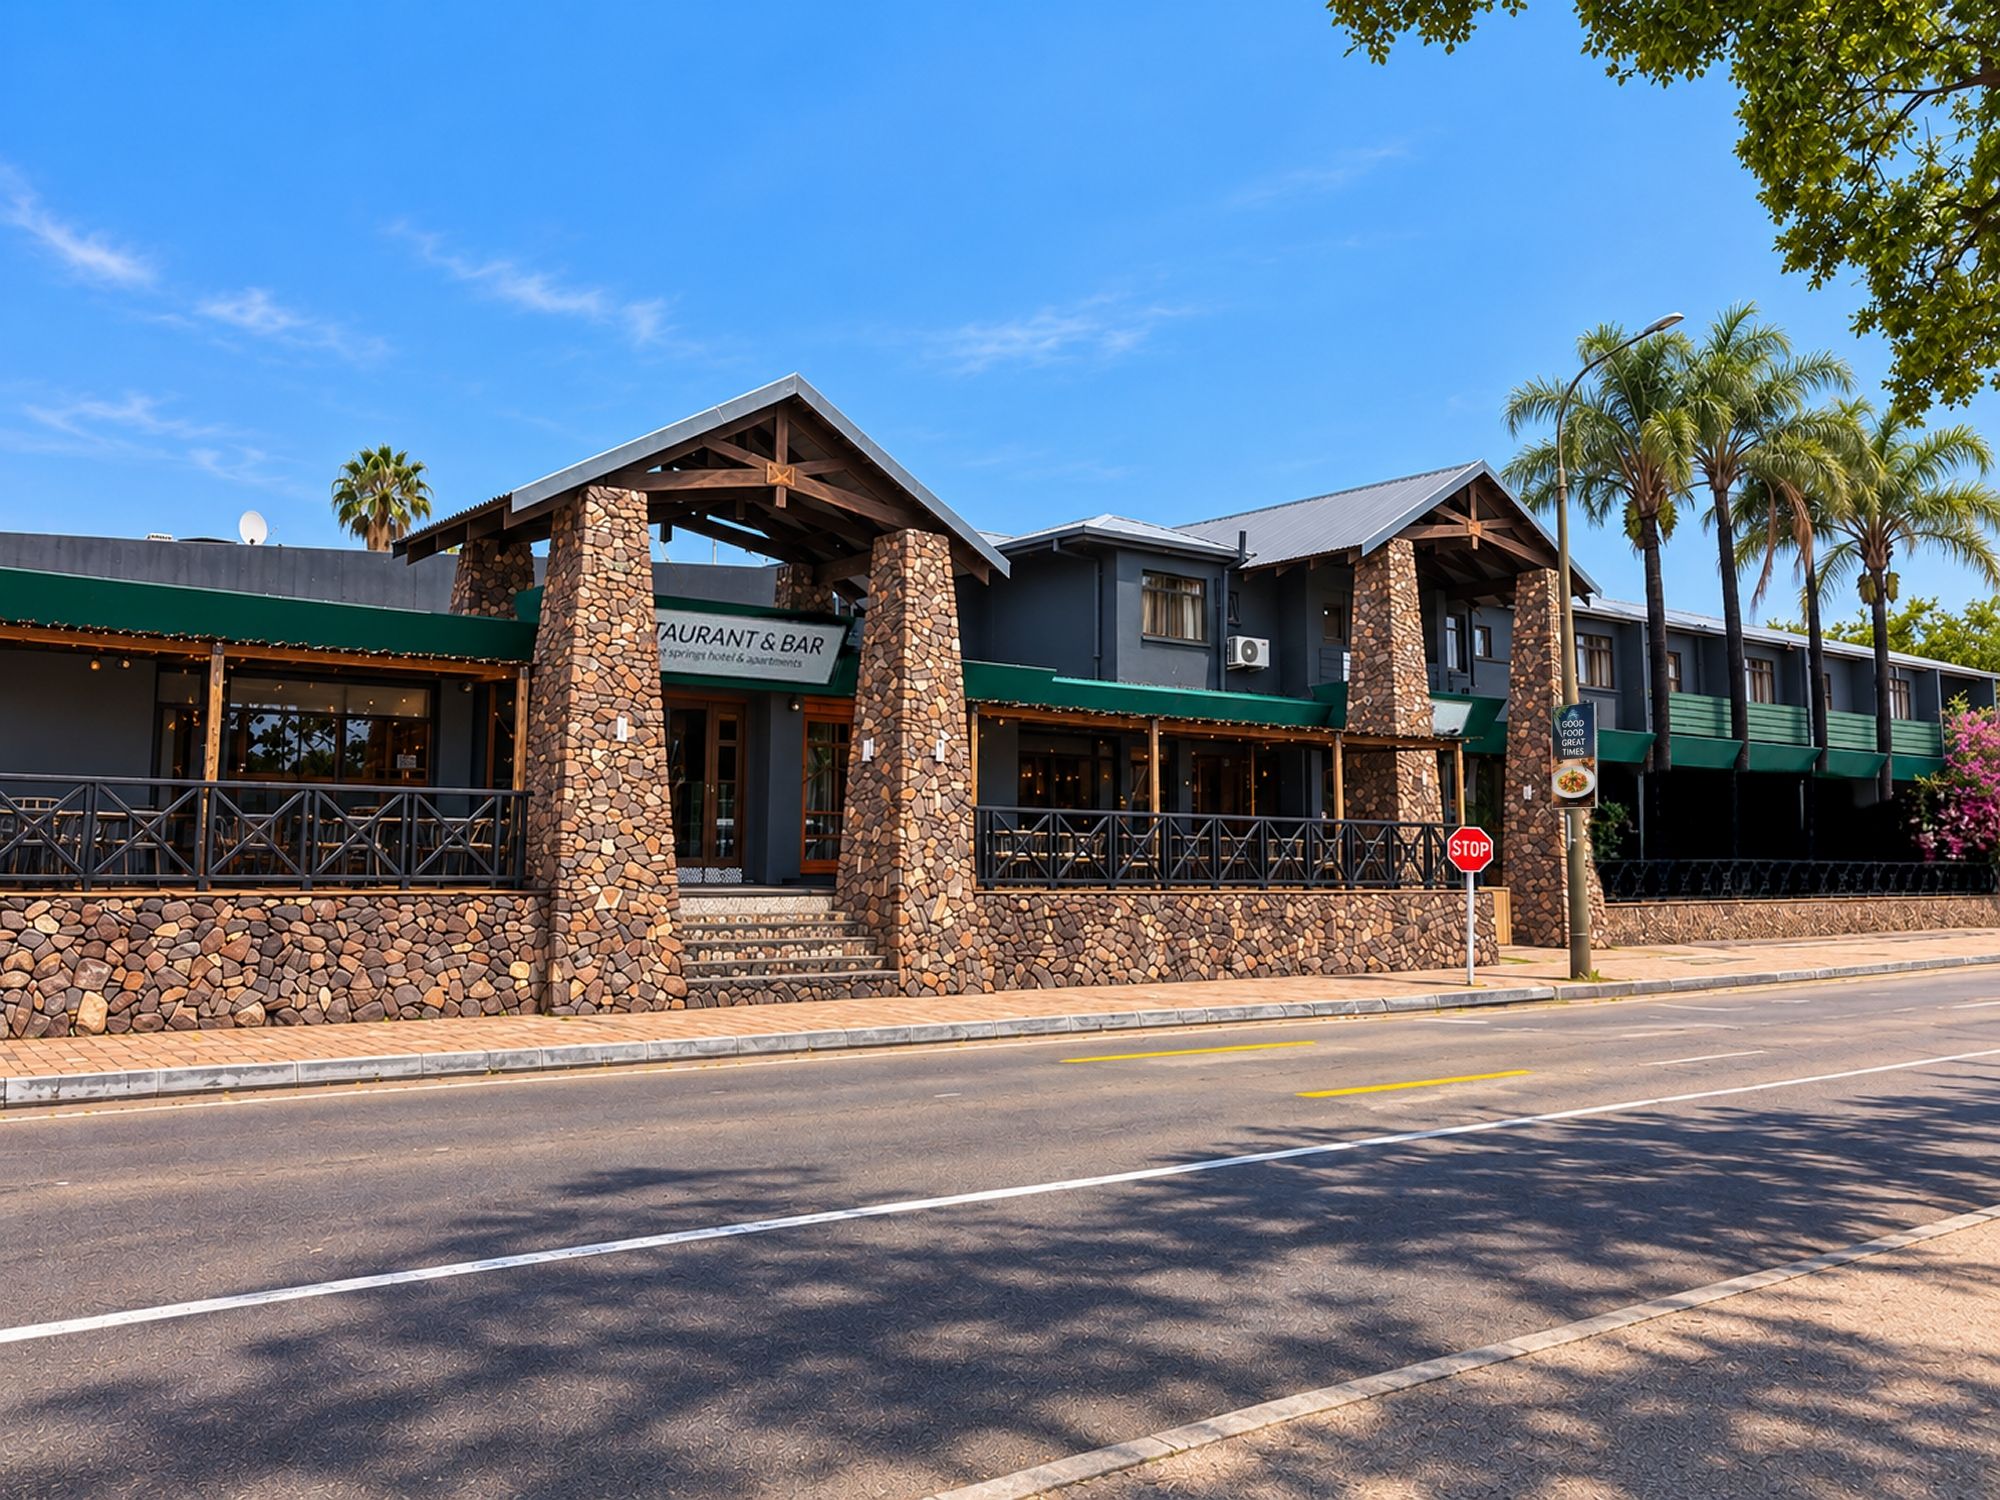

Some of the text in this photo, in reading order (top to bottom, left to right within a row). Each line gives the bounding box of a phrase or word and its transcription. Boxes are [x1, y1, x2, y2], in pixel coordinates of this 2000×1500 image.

[761, 632, 775, 651] &
[780, 633, 824, 655] BAR
[707, 650, 735, 663] hotel
[736, 652, 744, 663] &
[746, 655, 802, 668] apartments
[1561, 719, 1585, 729] GOOD
[1562, 729, 1584, 737] FOOD
[1561, 738, 1586, 747] GREAT
[1562, 747, 1585, 756] TIMES
[1452, 840, 1489, 857] STOP
